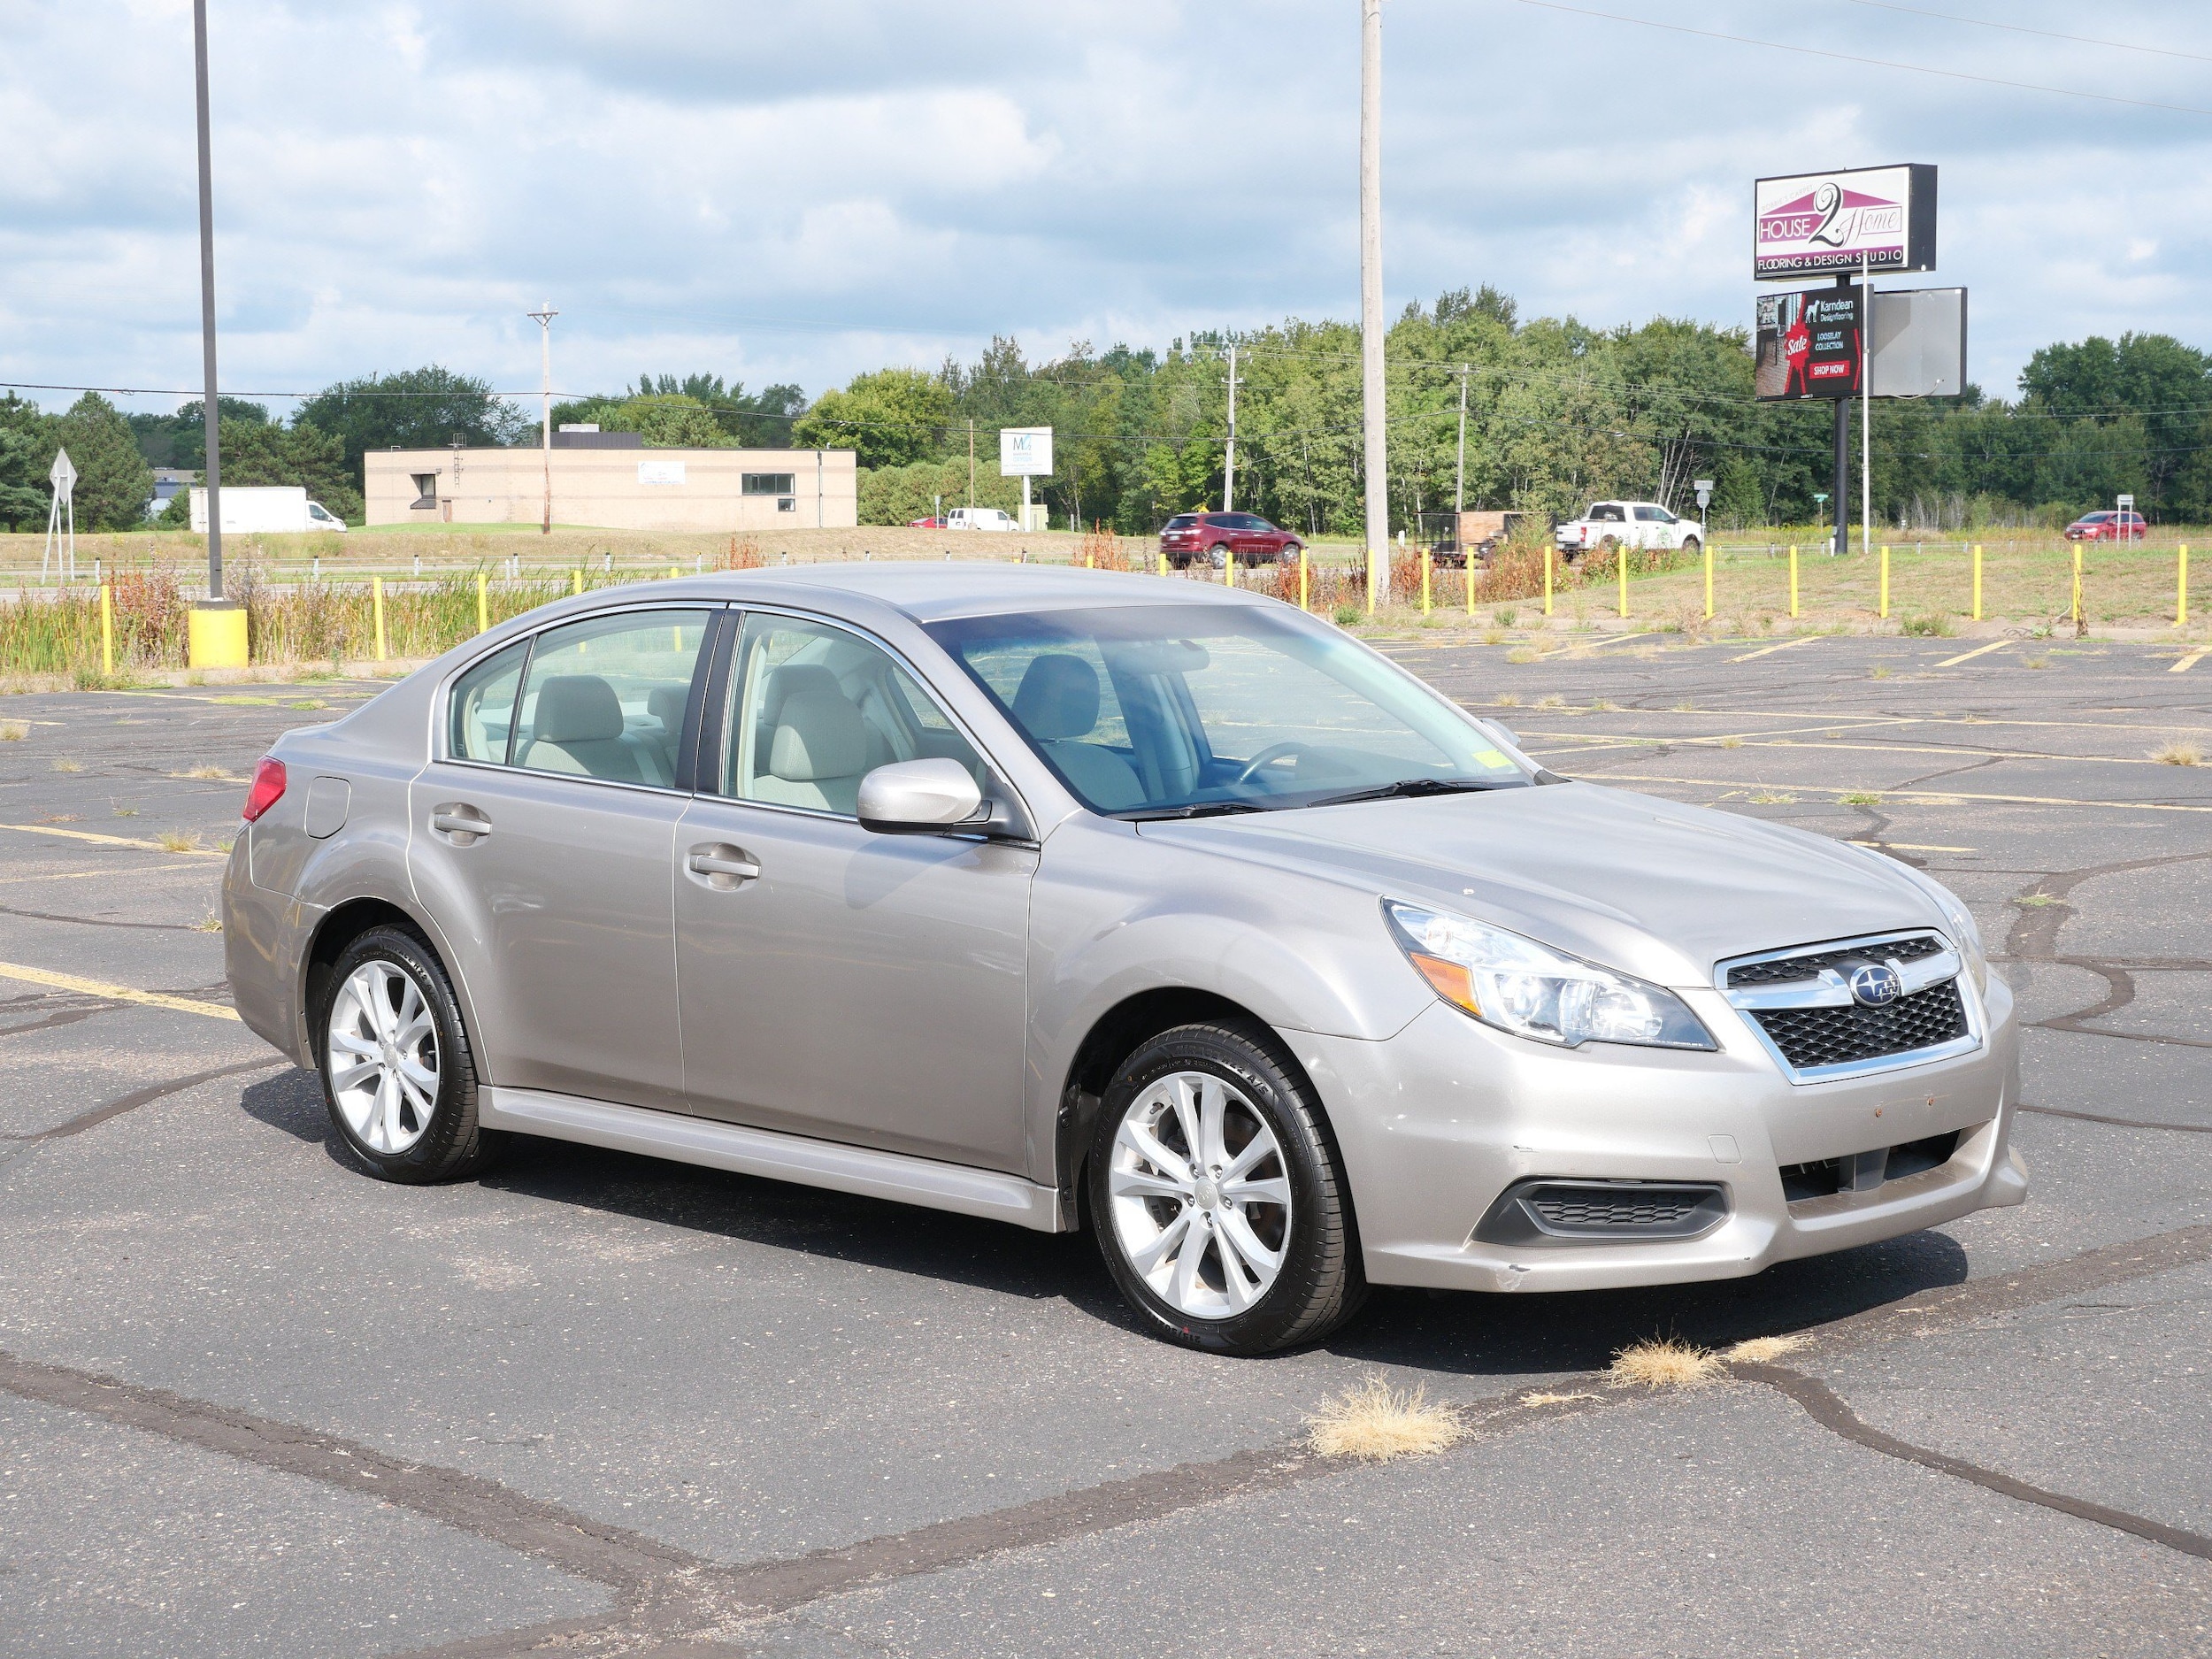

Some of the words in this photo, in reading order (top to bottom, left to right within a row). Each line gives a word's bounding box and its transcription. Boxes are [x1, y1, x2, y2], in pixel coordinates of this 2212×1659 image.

[1760, 218, 1811, 240] HOUSE
[1809, 182, 1845, 247] 2
[1838, 207, 1899, 247] Home
[1757, 256, 1802, 271] FLOORING
[1804, 257, 1812, 267] &
[1814, 253, 1853, 266] DESIGN
[1855, 249, 1902, 264] SUDIO
[1820, 299, 1854, 311] Karndean
[1787, 334, 1808, 356] Sale
[1815, 341, 1844, 351] COLLECTION
[1813, 365, 1829, 376] SHOP
[1830, 364, 1845, 374] NOW
